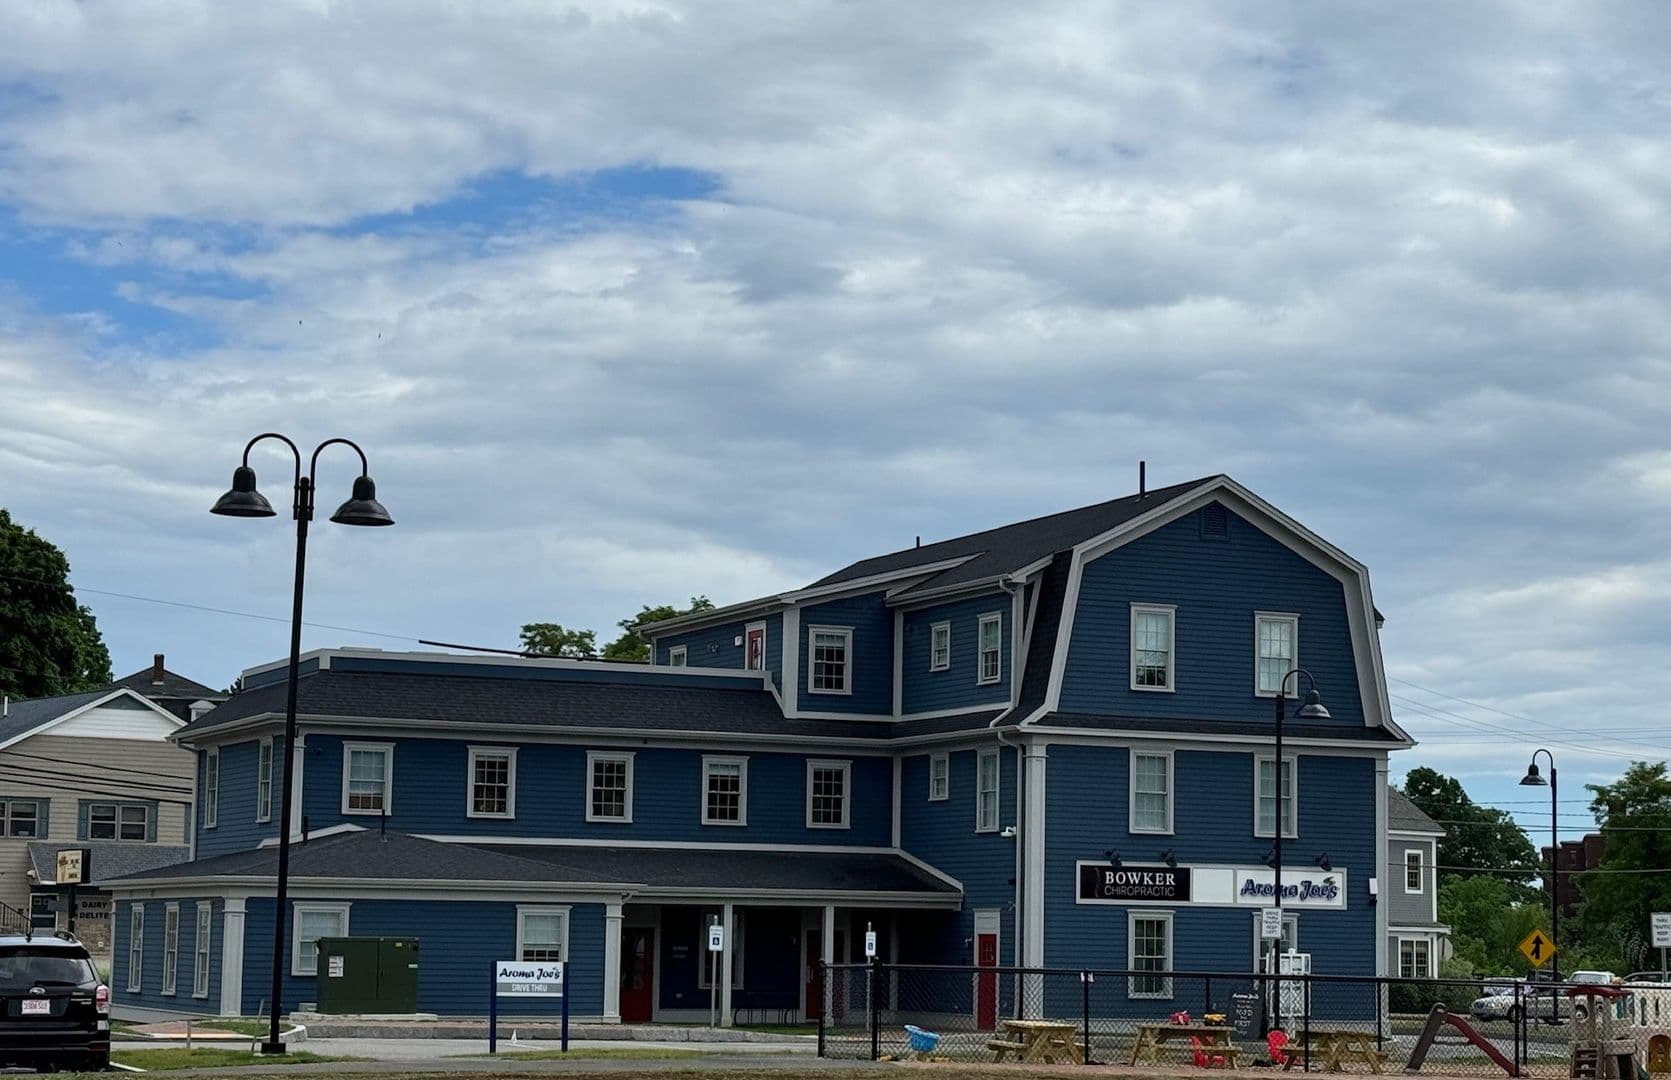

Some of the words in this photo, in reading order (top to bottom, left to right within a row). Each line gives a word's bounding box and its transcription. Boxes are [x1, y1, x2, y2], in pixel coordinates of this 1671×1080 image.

[1105, 871, 1176, 886] BOWKER
[1104, 885, 1175, 897] CHIROPRACTIC
[1241, 879, 1299, 898] Aroma
[1300, 877, 1338, 901] Joe's
[499, 968, 535, 979] Aroma
[536, 966, 561, 980] Joe's
[511, 983, 530, 992] DRIVE
[531, 983, 548, 992] THRU
